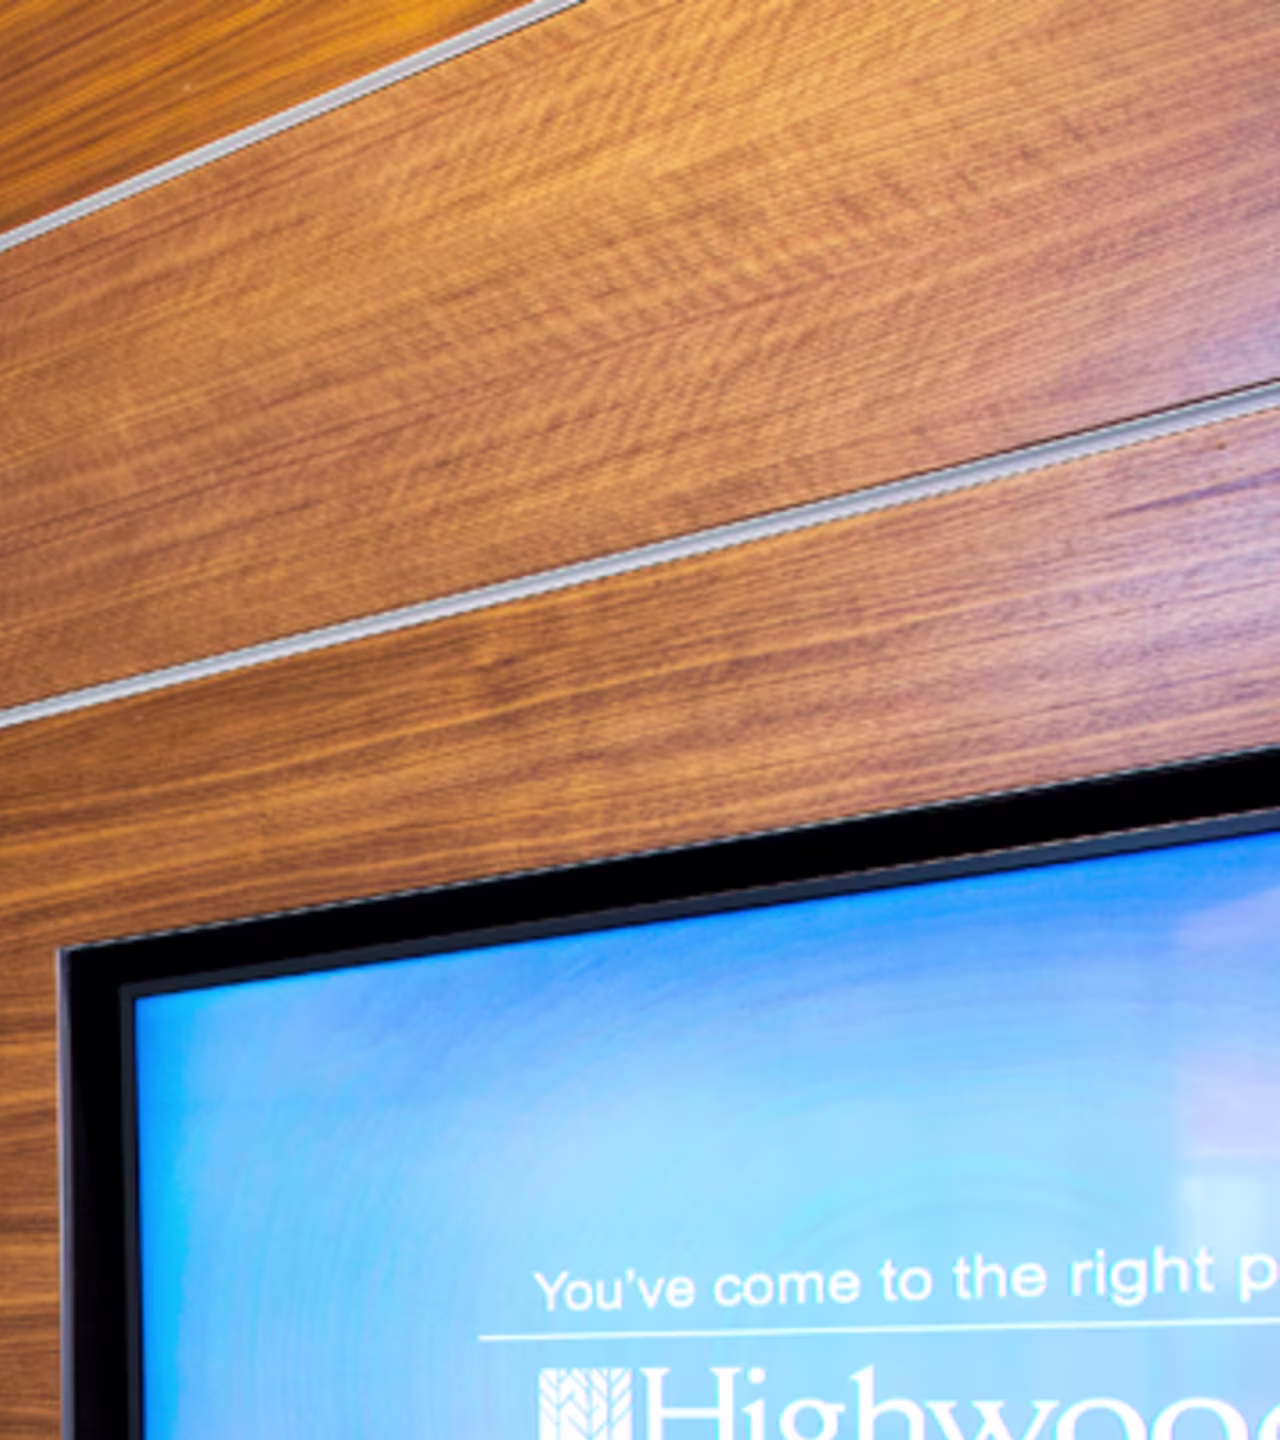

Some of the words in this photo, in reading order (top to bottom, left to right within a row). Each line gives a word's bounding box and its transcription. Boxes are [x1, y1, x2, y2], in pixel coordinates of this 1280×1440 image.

[533, 1267, 697, 1312] You've
[713, 1268, 860, 1307] come
[878, 1258, 933, 1302] to
[952, 1252, 1048, 1301] the
[1069, 1245, 1215, 1308] right
